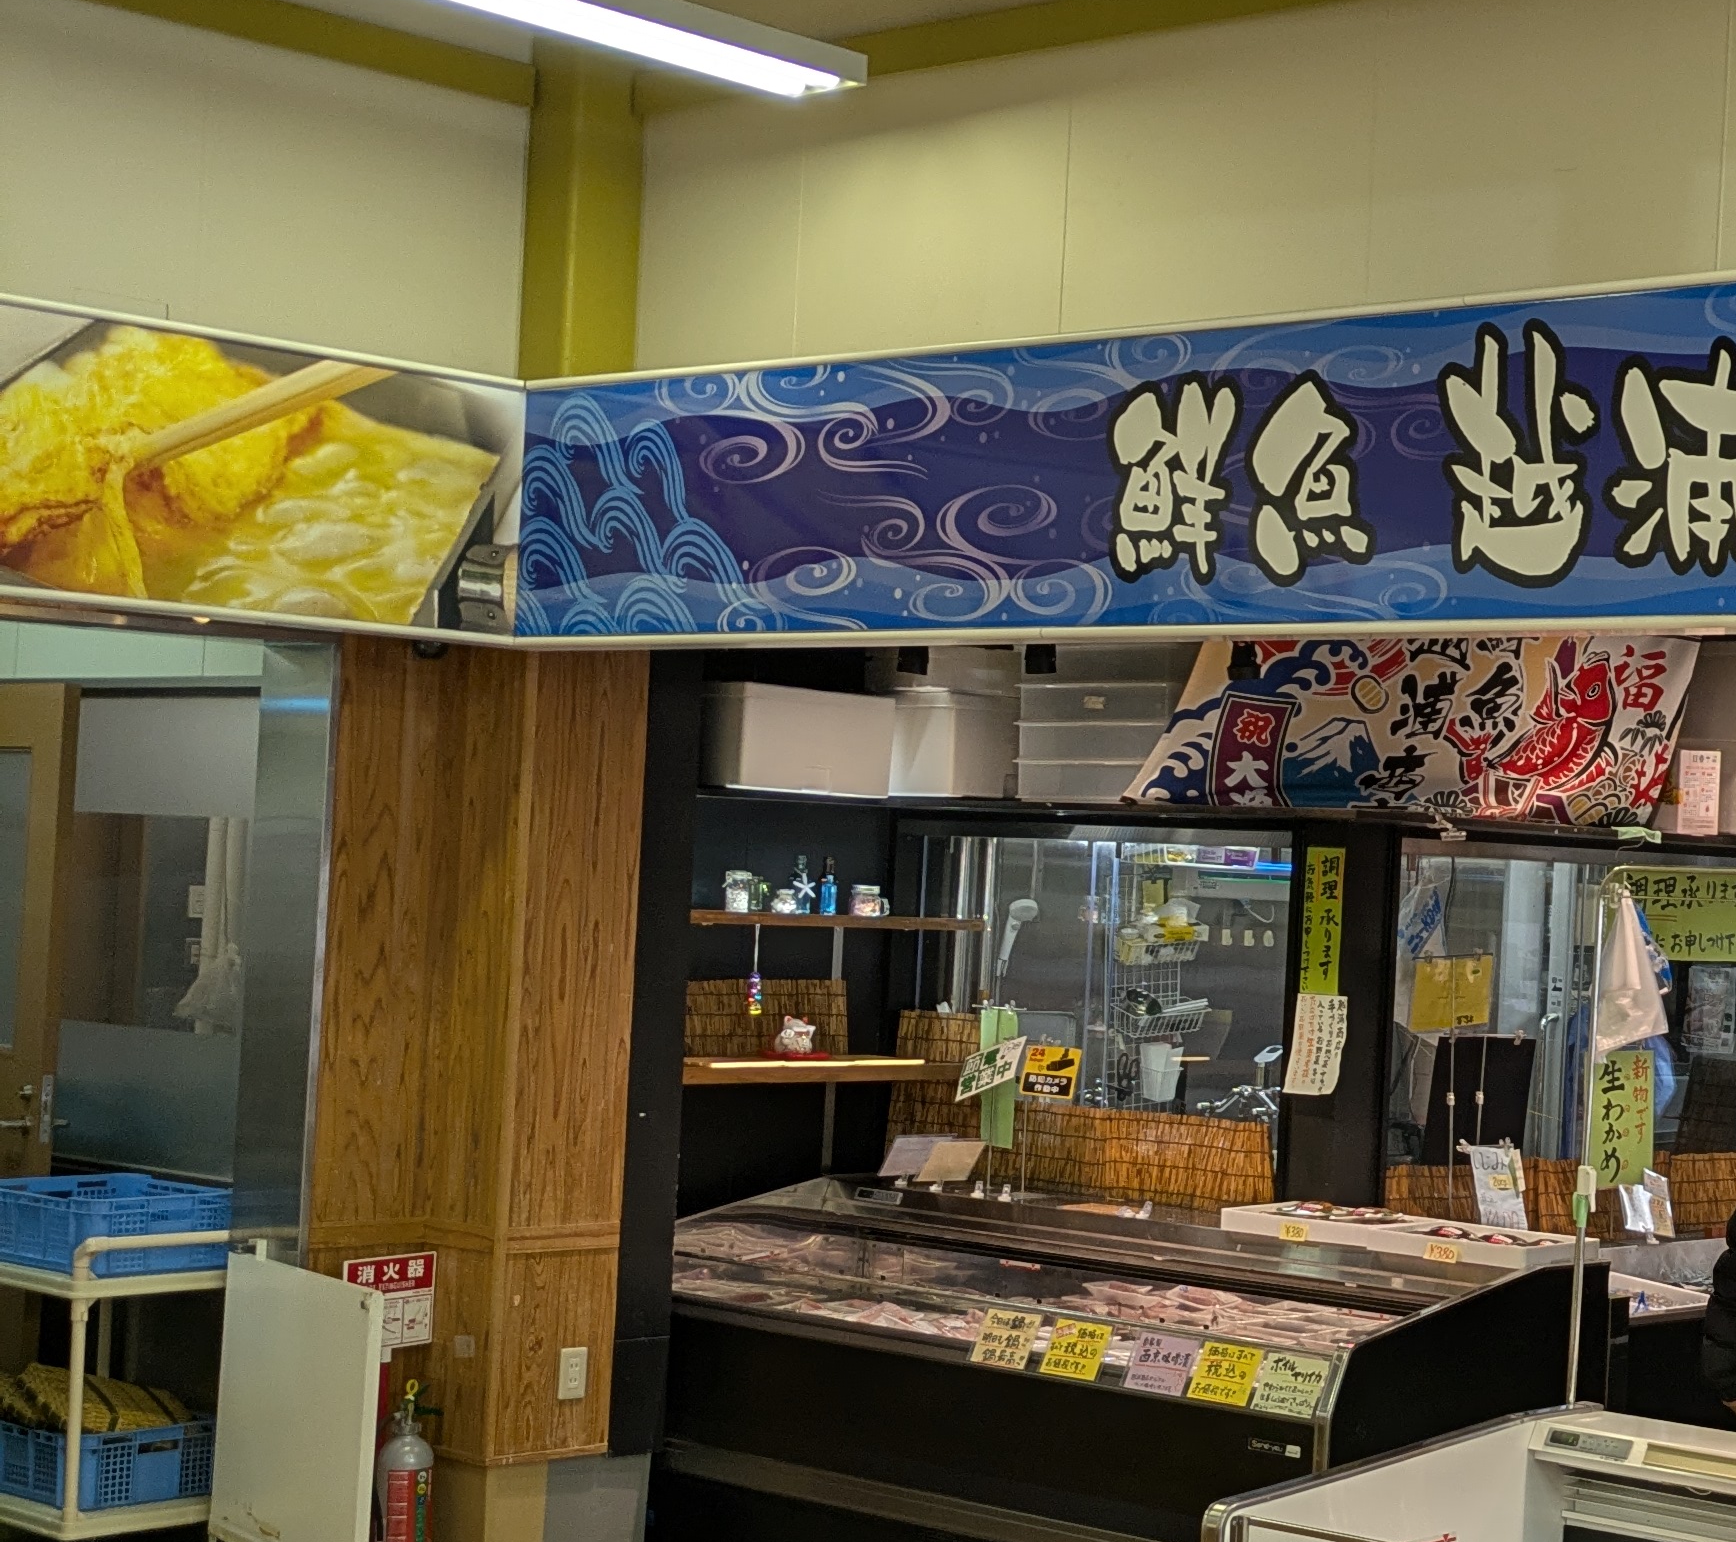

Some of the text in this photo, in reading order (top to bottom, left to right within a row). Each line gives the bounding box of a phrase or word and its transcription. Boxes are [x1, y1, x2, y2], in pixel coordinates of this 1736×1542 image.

[1111, 373, 1374, 583] 鮮魚
[1614, 645, 1667, 712] 福
[357, 1258, 426, 1284] 消火器
